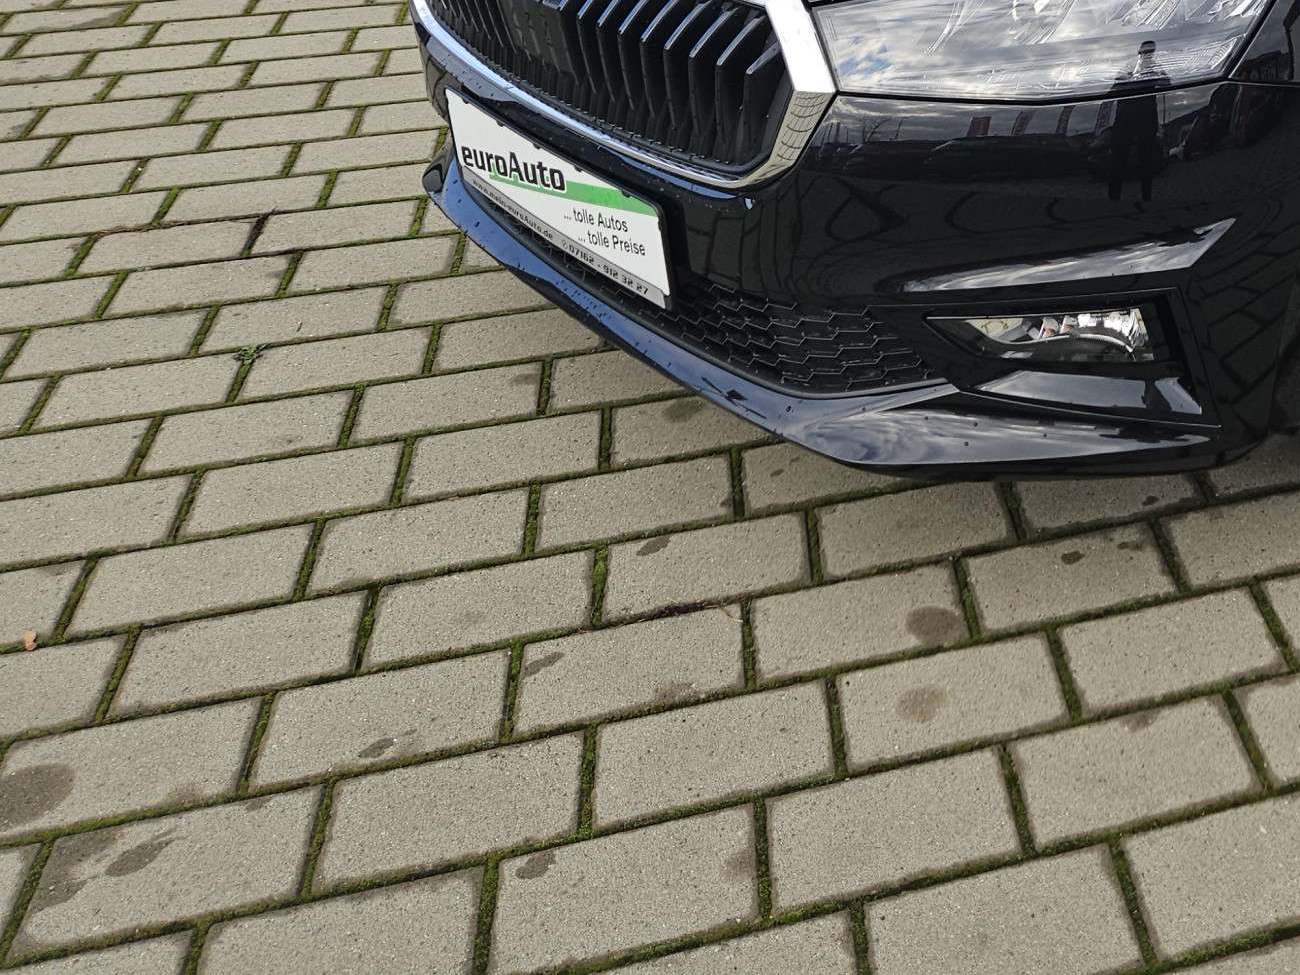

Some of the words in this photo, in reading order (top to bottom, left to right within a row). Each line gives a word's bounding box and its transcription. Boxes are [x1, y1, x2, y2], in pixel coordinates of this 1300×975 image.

[461, 145, 565, 191] euroAuto
[573, 207, 595, 226] tolle
[598, 212, 628, 233] Autos
[587, 229, 610, 248] tolle
[612, 234, 646, 256] Preise
